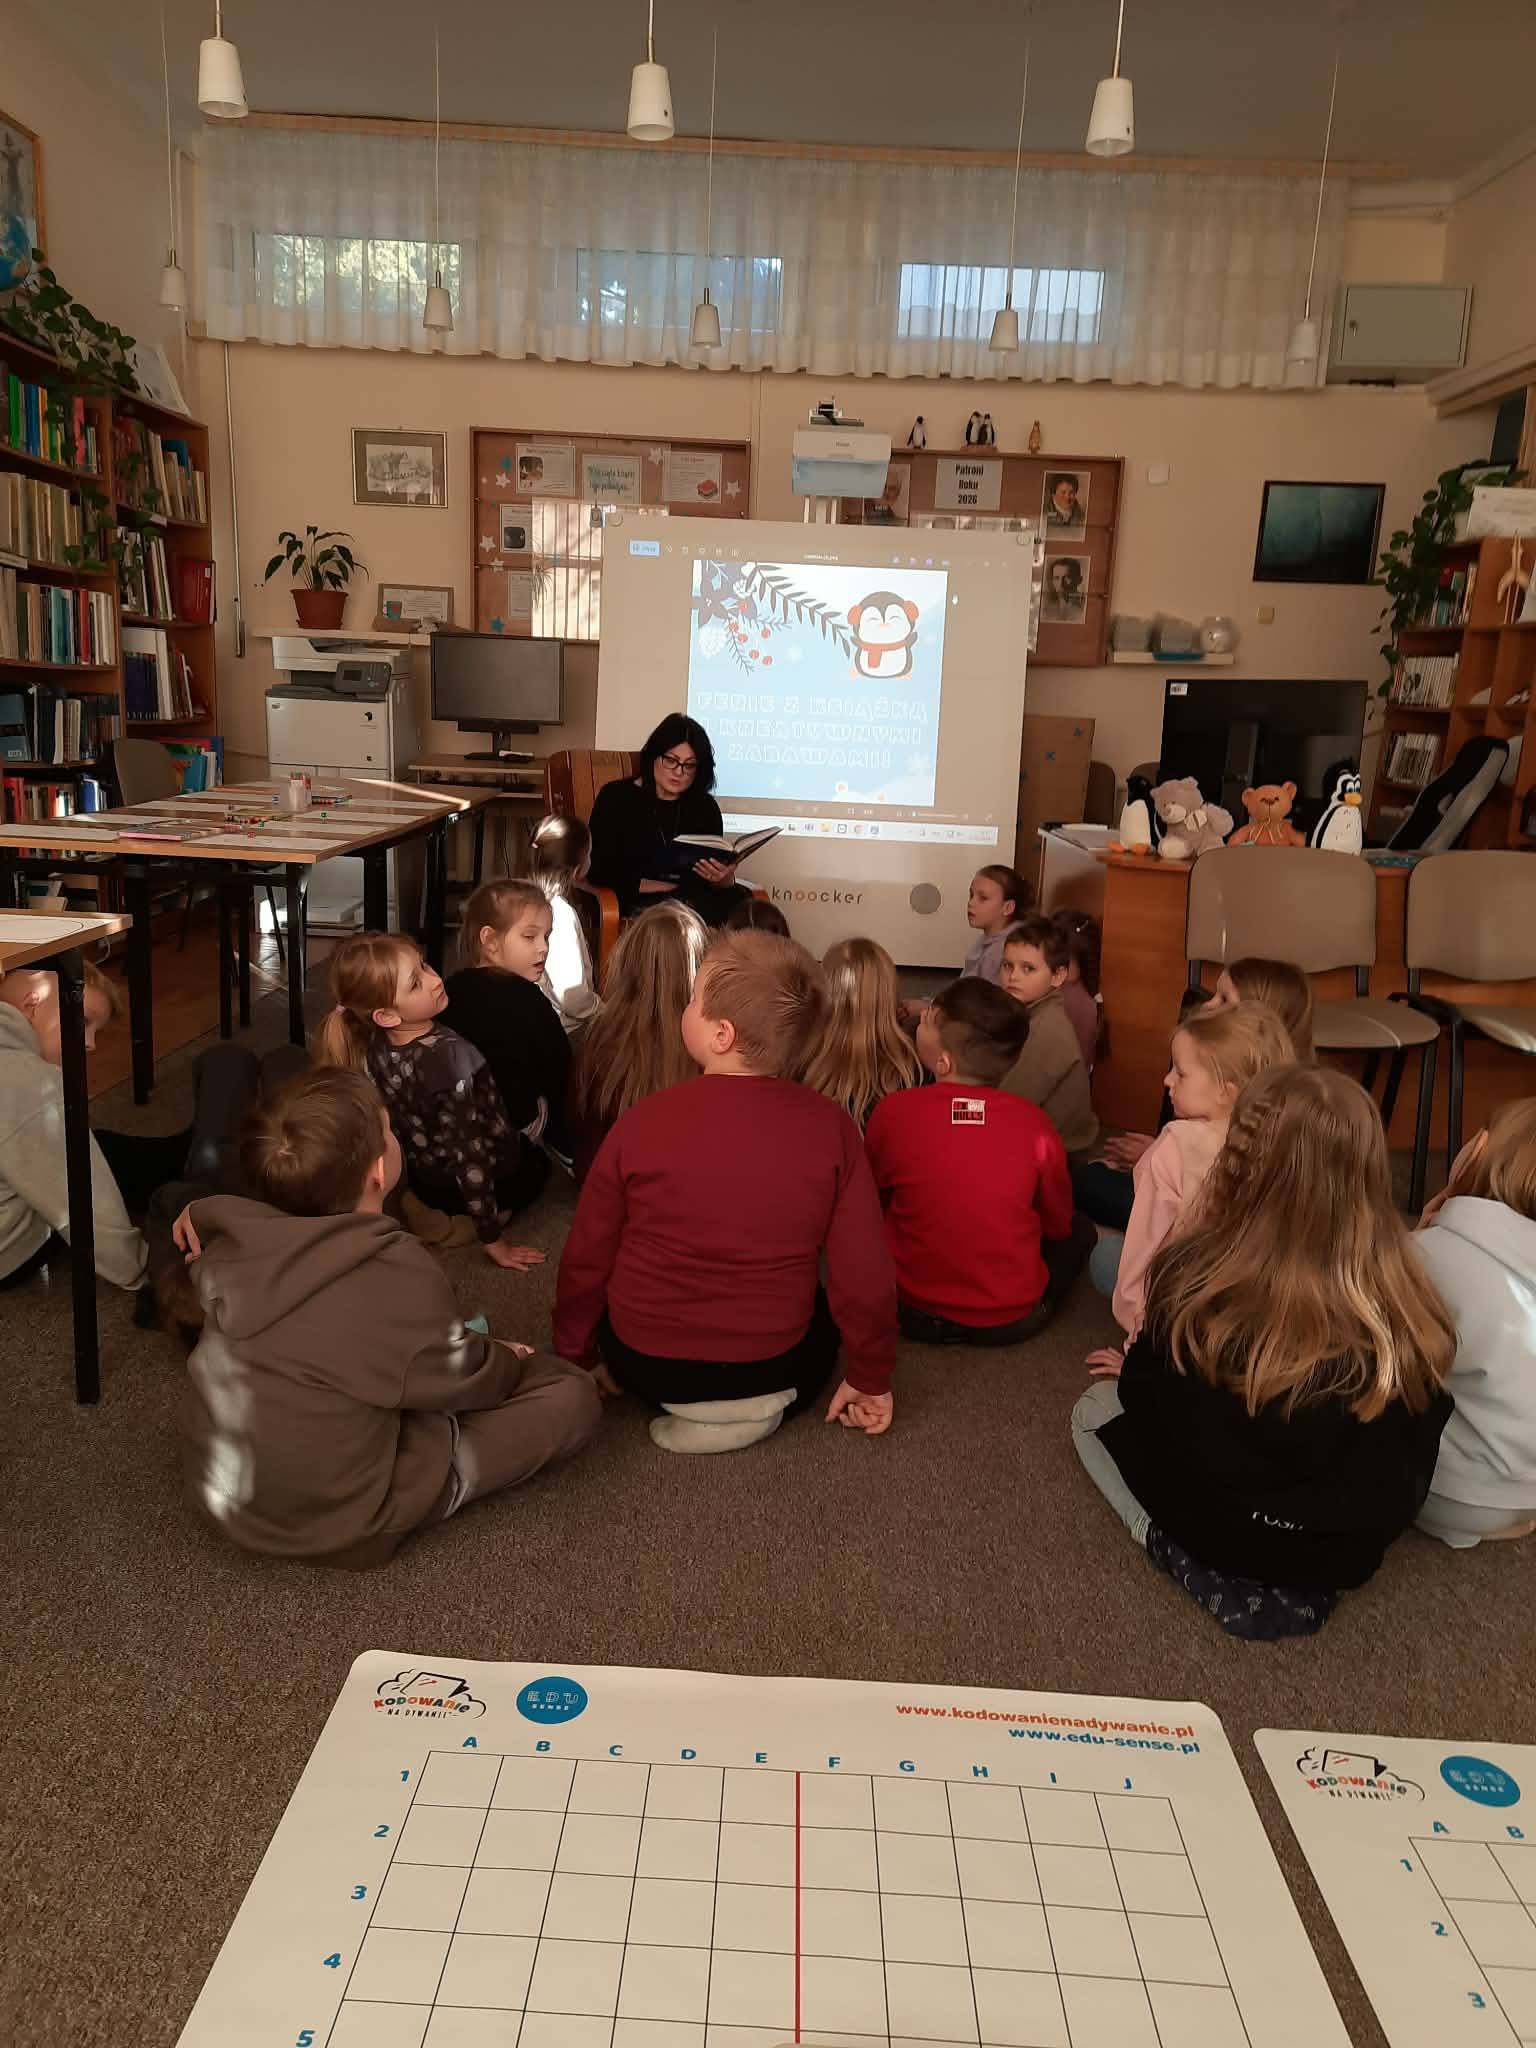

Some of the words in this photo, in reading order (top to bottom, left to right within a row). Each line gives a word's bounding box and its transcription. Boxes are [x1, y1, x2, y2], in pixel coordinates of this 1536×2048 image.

[955, 463, 984, 476] Patroni
[958, 479, 979, 490] Roku
[957, 494, 978, 505] 2026
[771, 885, 863, 905] knoocker
[387, 1708, 400, 1716] NA
[896, 1704, 1195, 1738] www.kodowanienadywanie.pl
[1008, 1728, 1200, 1755] www.edu-sense.pl
[462, 1736, 478, 1748] A
[535, 1740, 551, 1752] B
[608, 1744, 623, 1756] C
[681, 1748, 697, 1760] D
[755, 1752, 768, 1764] E
[828, 1756, 841, 1768] F
[899, 1760, 915, 1772] G
[972, 1765, 989, 1778] H
[1050, 1772, 1057, 1784] I
[1123, 1777, 1133, 1790] J
[400, 1770, 410, 1782] 1
[373, 1824, 390, 1838] 2
[1432, 1820, 1450, 1835] A
[1505, 1825, 1525, 1839] B
[1400, 1858, 1413, 1873] 1
[350, 1884, 368, 1900] 3
[1431, 1920, 1449, 1937] 2
[323, 1952, 341, 1969] 4
[1466, 1991, 1486, 2009] 3
[295, 2029, 316, 2048] 5
